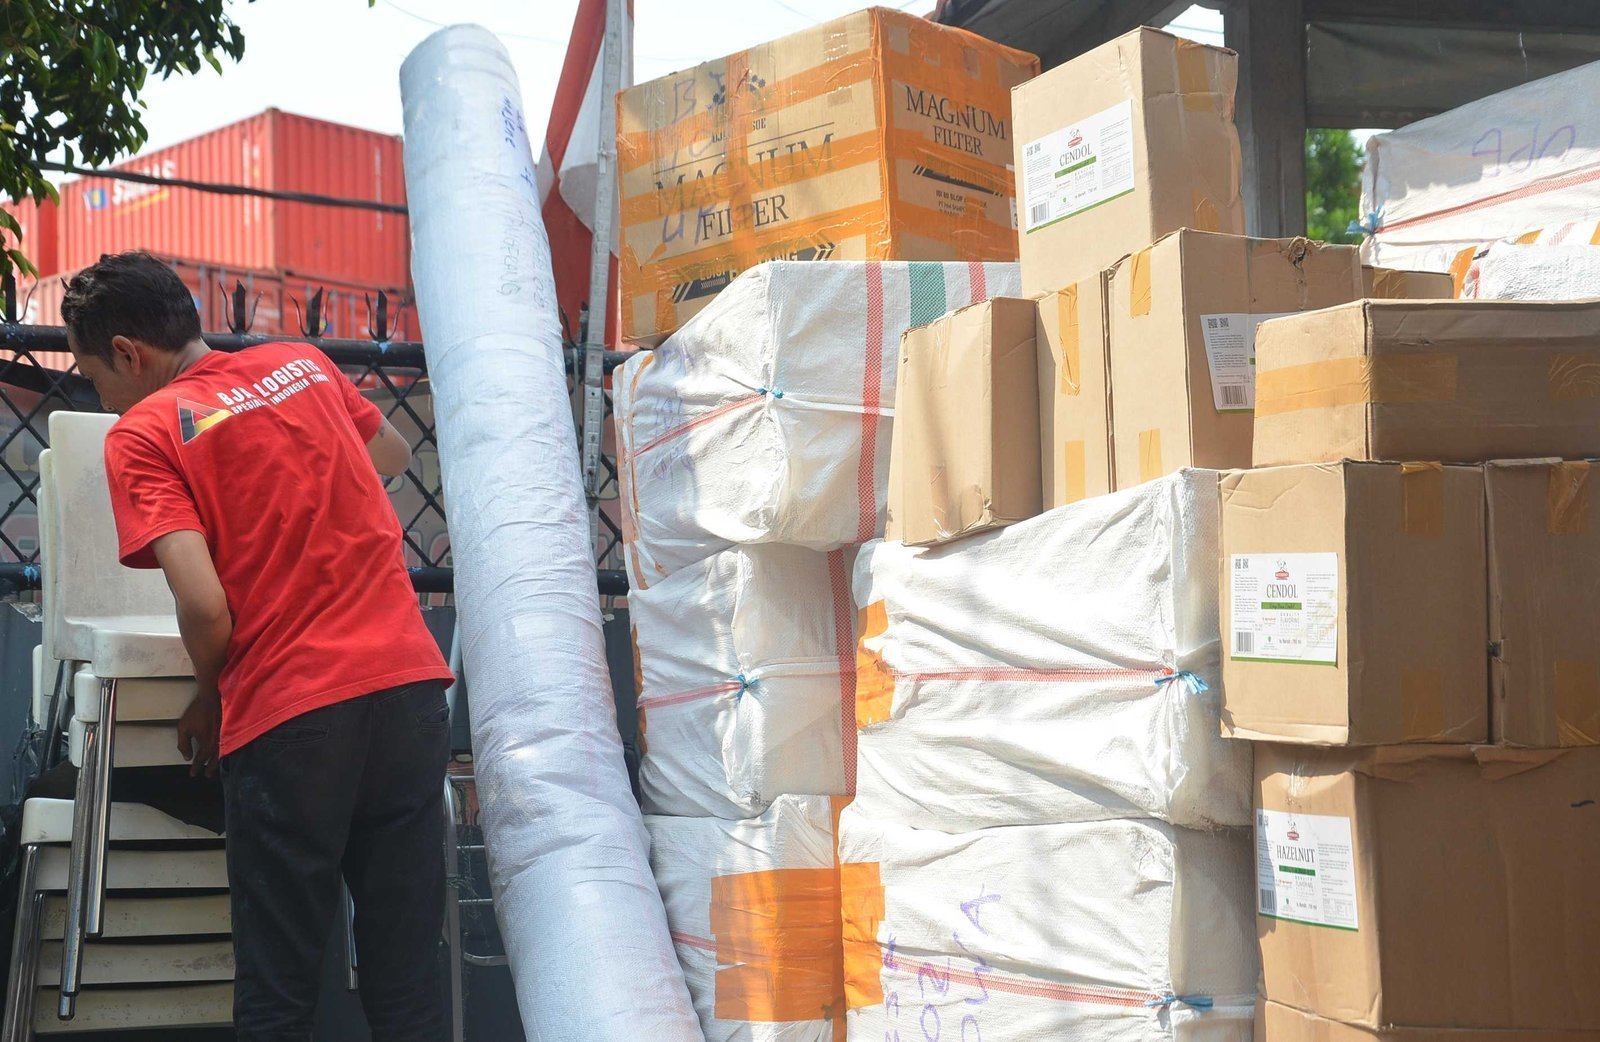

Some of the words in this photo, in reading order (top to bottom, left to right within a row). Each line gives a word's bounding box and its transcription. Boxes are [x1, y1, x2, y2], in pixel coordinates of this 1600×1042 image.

[905, 85, 1007, 140] MAGNUM
[933, 124, 984, 156] FILTER
[1059, 143, 1093, 167] CENDOL
[655, 132, 834, 216] MAGNUM
[701, 194, 789, 240] FILTER
[217, 387, 257, 406] BJA
[253, 358, 322, 398] LOGISTIC
[270, 378, 311, 405] INDONESIA
[1266, 584, 1298, 599] CENDOL
[1276, 844, 1316, 863] HAZELNUT
